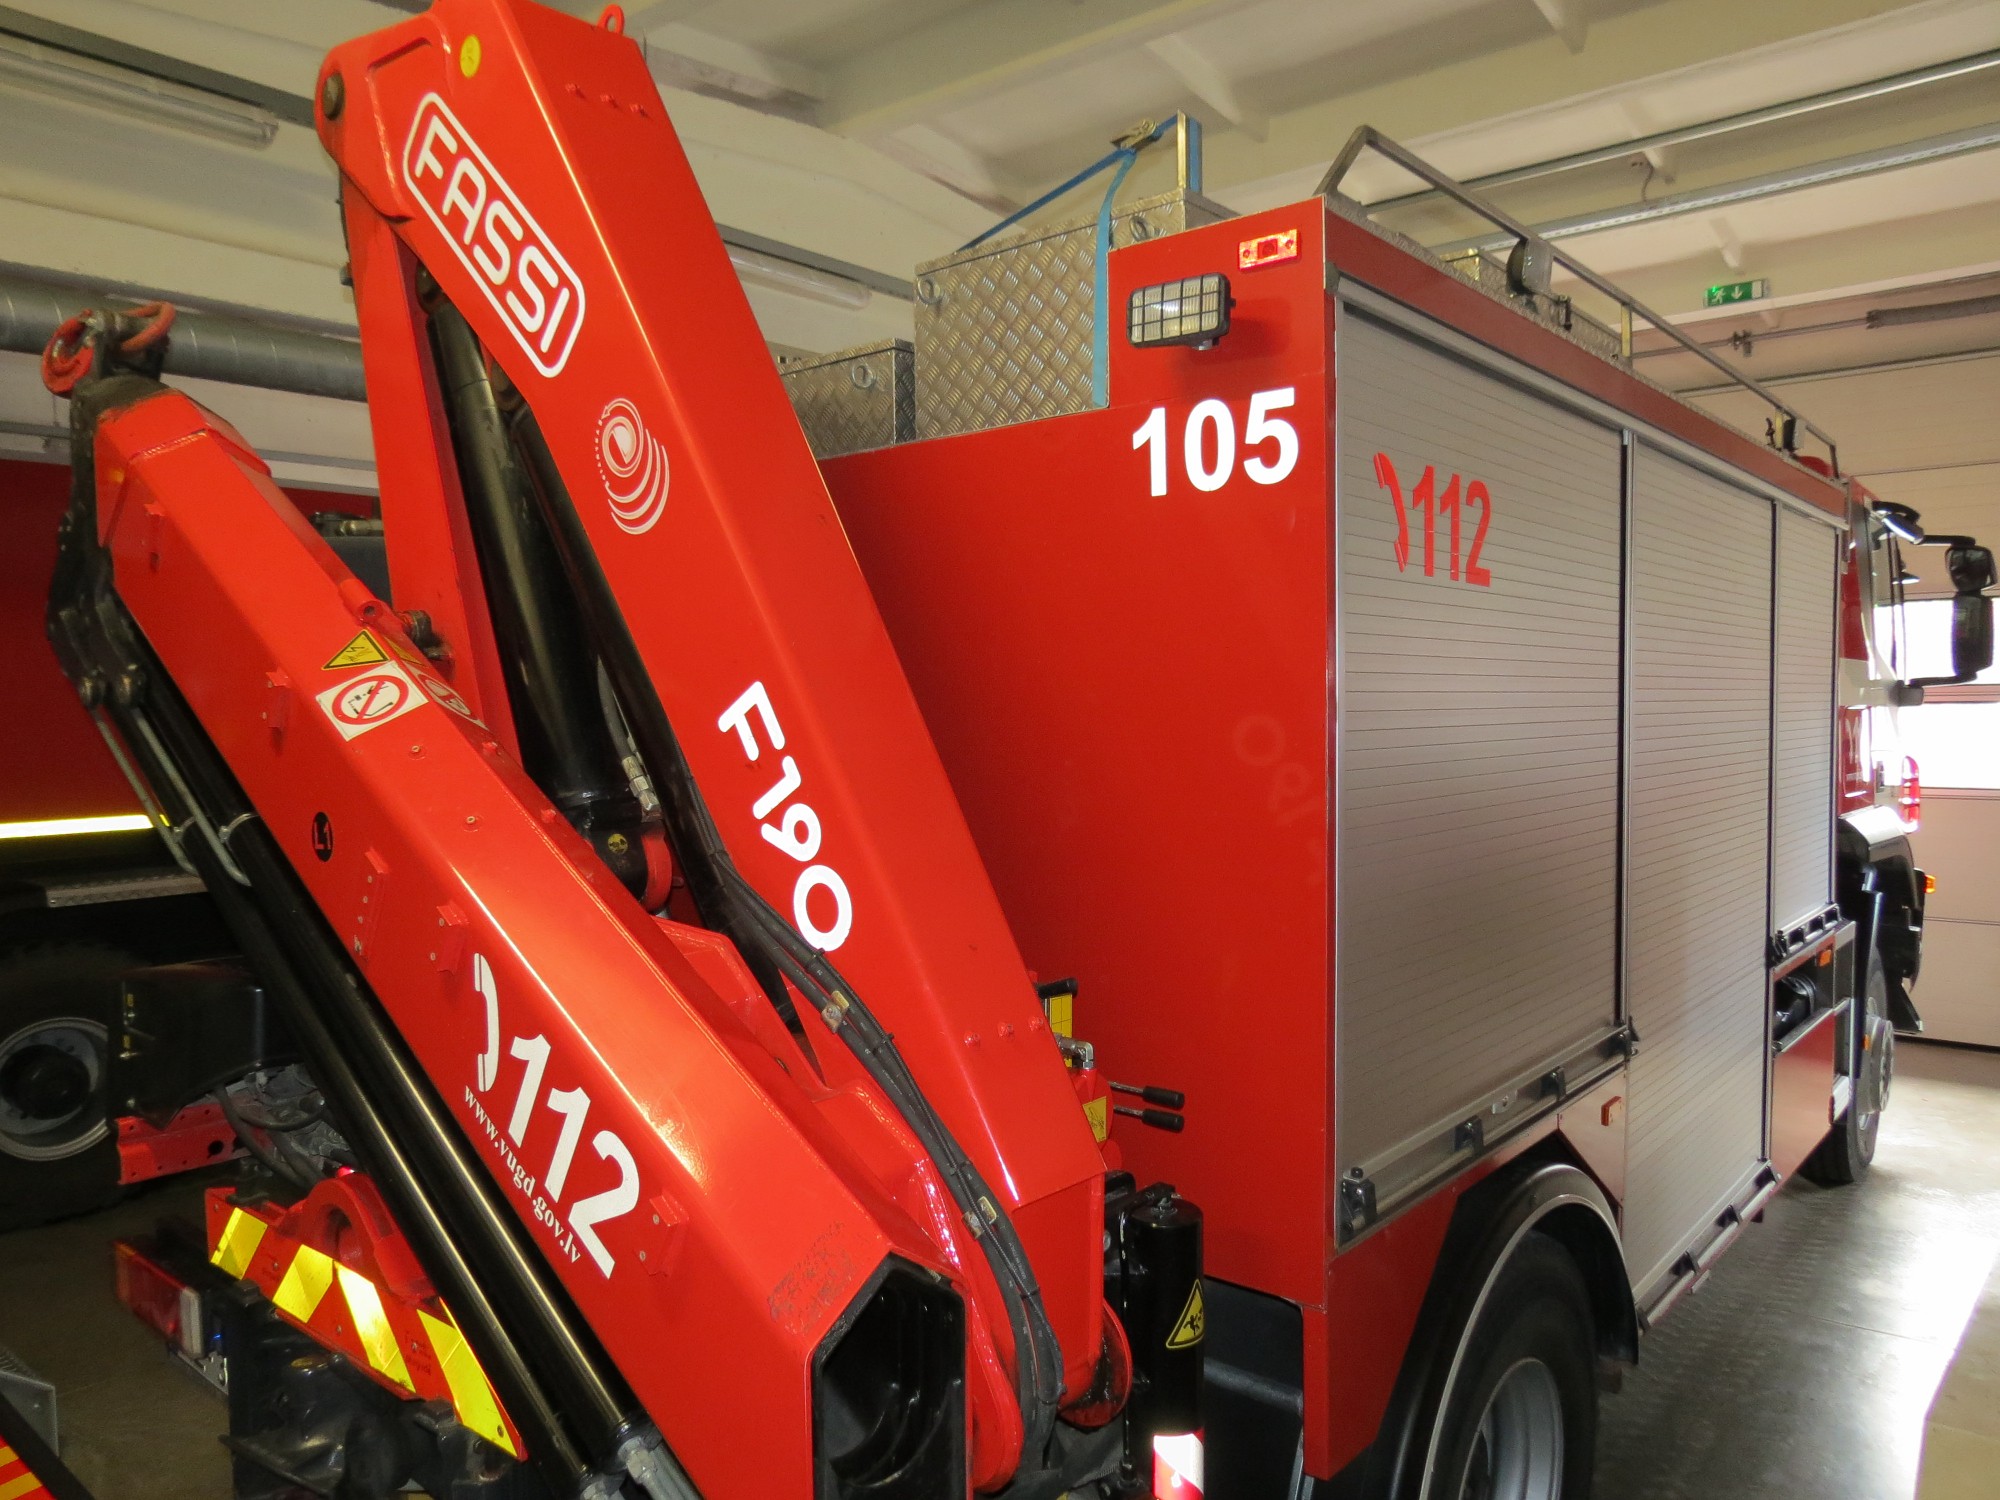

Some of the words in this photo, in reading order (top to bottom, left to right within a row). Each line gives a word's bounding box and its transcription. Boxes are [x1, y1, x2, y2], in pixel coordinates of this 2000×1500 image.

[415, 115, 569, 353] FASSI
[1133, 387, 1299, 497] 105
[1412, 465, 1491, 587] 112
[313, 821, 332, 850] L1
[718, 681, 853, 952] F190
[464, 1085, 581, 1263] www.vugd.gov.lv
[508, 1034, 640, 1280] 112
